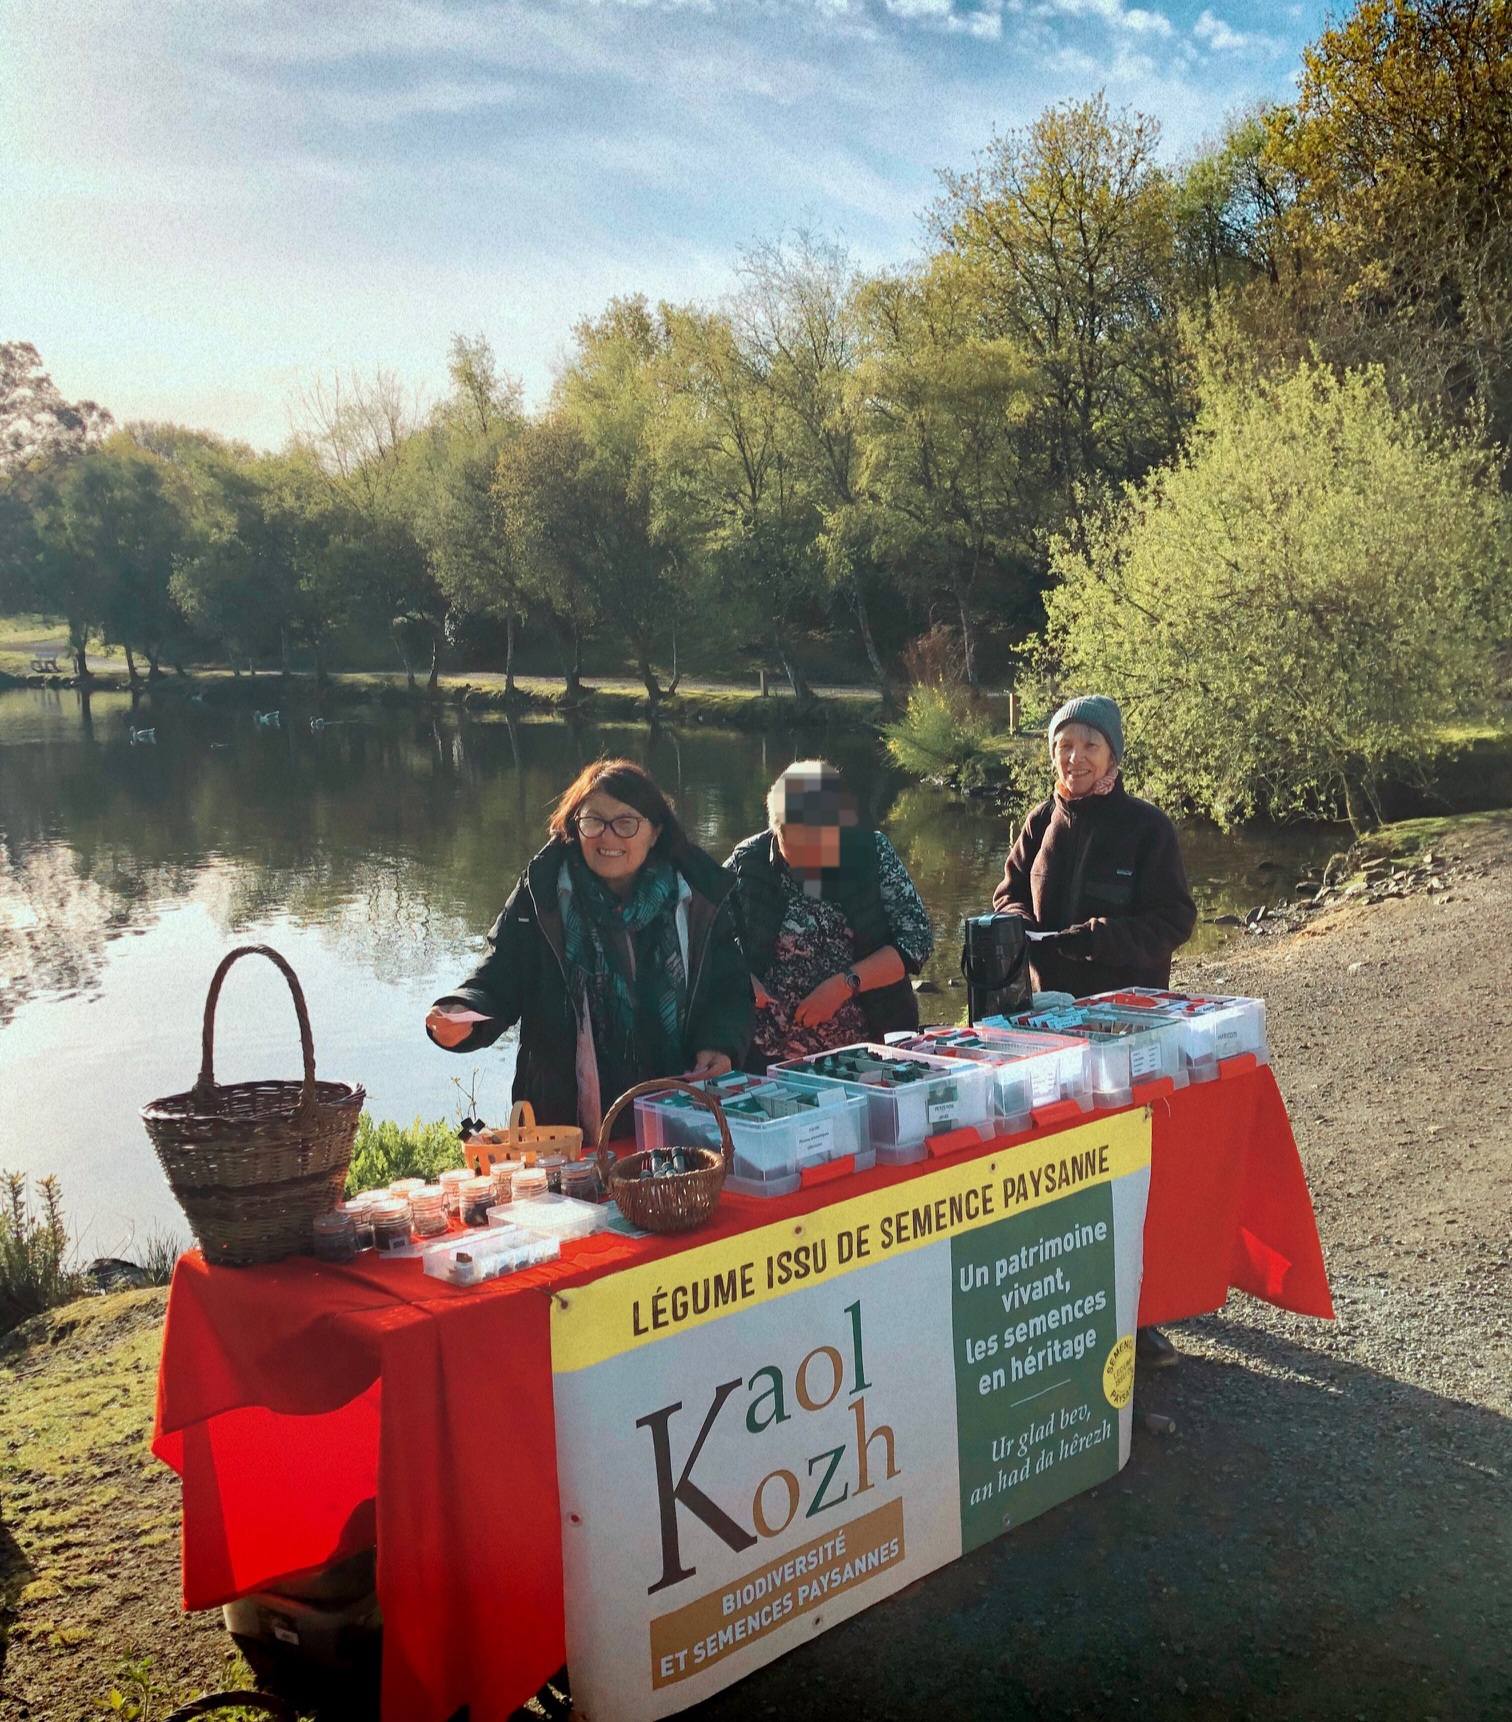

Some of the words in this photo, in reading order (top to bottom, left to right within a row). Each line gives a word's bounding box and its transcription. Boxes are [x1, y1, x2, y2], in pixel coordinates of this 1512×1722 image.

[633, 1262, 755, 1336] LÉGUME
[767, 1239, 827, 1289] ISSU
[837, 1224, 871, 1264] DE
[880, 1184, 995, 1249] SEMENCE
[1003, 1144, 1110, 1208] PAYSANNE
[960, 1263, 989, 1292] Un
[995, 1221, 1107, 1286] patrimoine
[965, 1334, 999, 1364] les
[1004, 1290, 1107, 1348] semences
[1001, 1267, 1071, 1313] vivant,
[978, 1367, 1006, 1395] en
[1011, 1328, 1097, 1382] héritage
[636, 1299, 872, 1595] Kaol
[970, 1480, 993, 1506] an
[998, 1457, 1030, 1492] had
[1035, 1449, 1054, 1475] da
[1059, 1419, 1111, 1461] hêrezh
[992, 1435, 1015, 1462] Ur
[1017, 1412, 1055, 1457] glad
[1060, 1403, 1092, 1430] bev,
[660, 1649, 688, 1678] ET
[693, 1593, 793, 1665] SEMENCES
[797, 1537, 900, 1606] PAYSANNES
[722, 1529, 847, 1616] BIODIVERSITÉ
